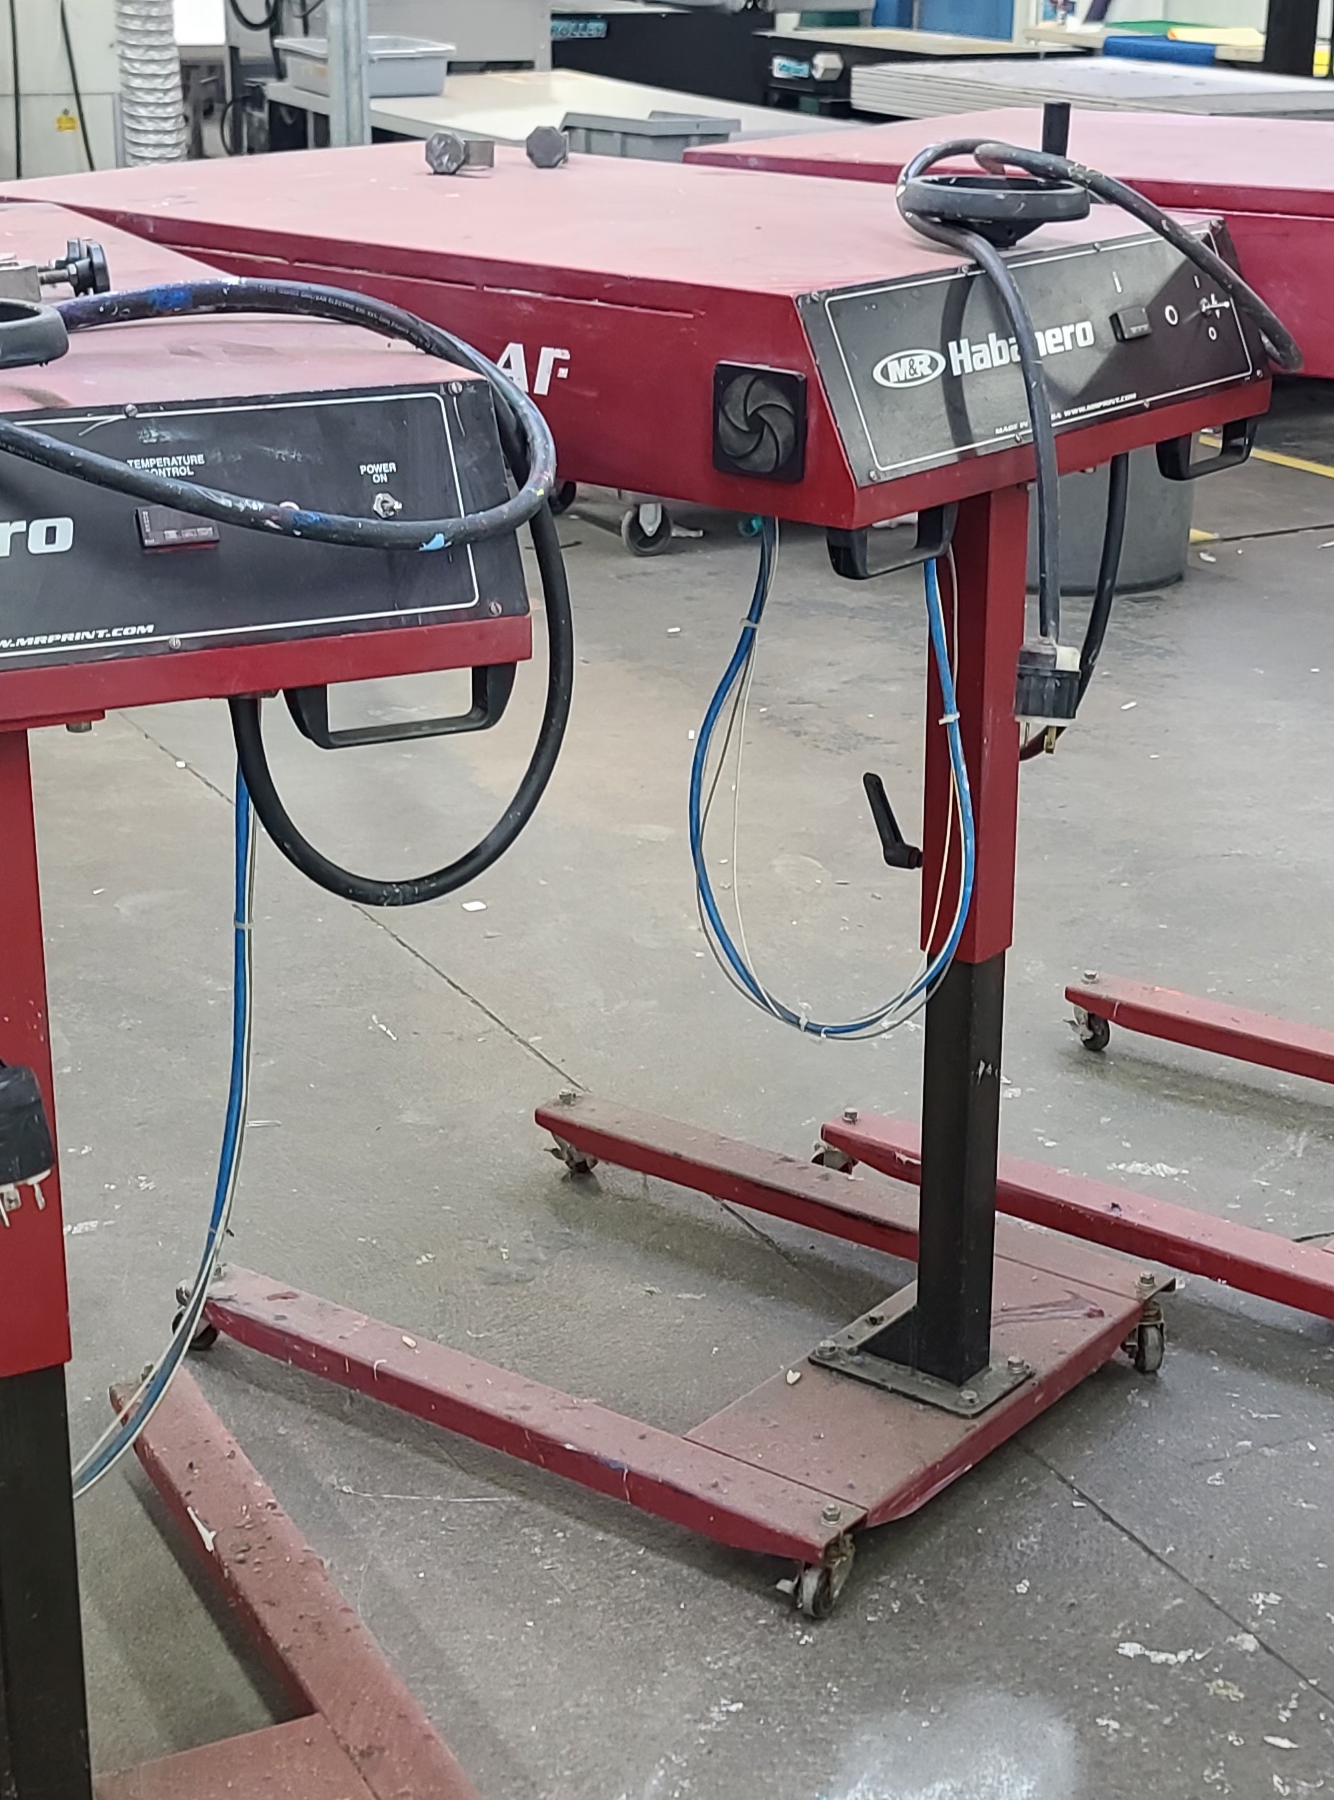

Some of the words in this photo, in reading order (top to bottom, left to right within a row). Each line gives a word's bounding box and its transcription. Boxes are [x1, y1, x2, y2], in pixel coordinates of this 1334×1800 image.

[126, 454, 205, 470] TEMPERATURE
[145, 465, 195, 477] ONTROL
[359, 462, 397, 475] POWER
[372, 473, 388, 483] ON
